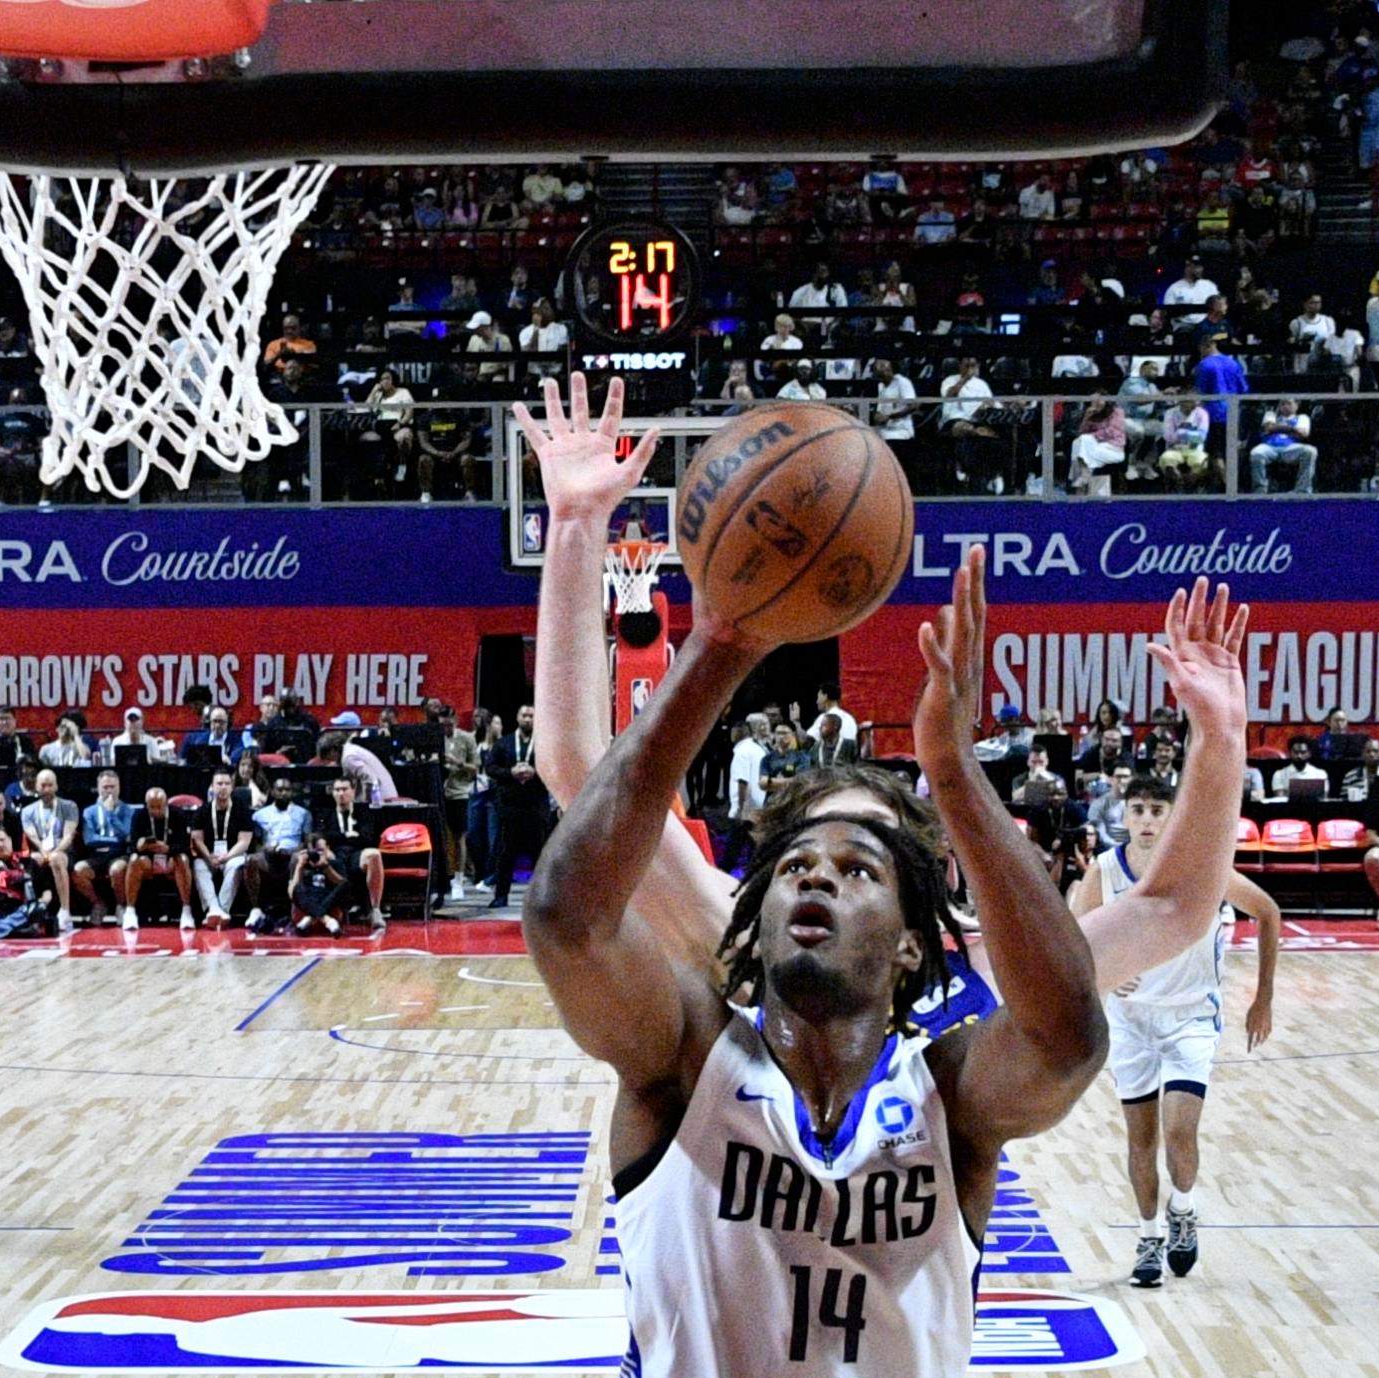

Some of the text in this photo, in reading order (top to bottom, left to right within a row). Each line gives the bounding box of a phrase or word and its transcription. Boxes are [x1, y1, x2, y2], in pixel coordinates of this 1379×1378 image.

[609, 241, 675, 274] 2:17
[620, 273, 670, 331] 14
[610, 353, 686, 370] TISSOT
[101, 531, 301, 586] Courtside
[912, 523, 1293, 579] LTRA Courtside
[137, 653, 240, 707] STARS
[253, 653, 334, 707] PLAY
[346, 653, 429, 707] HERE
[991, 632, 1184, 724] SUMM
[878, 1129, 927, 1150] CHASE
[718, 1140, 938, 1247] DALLAS
[789, 1265, 867, 1363] 14
